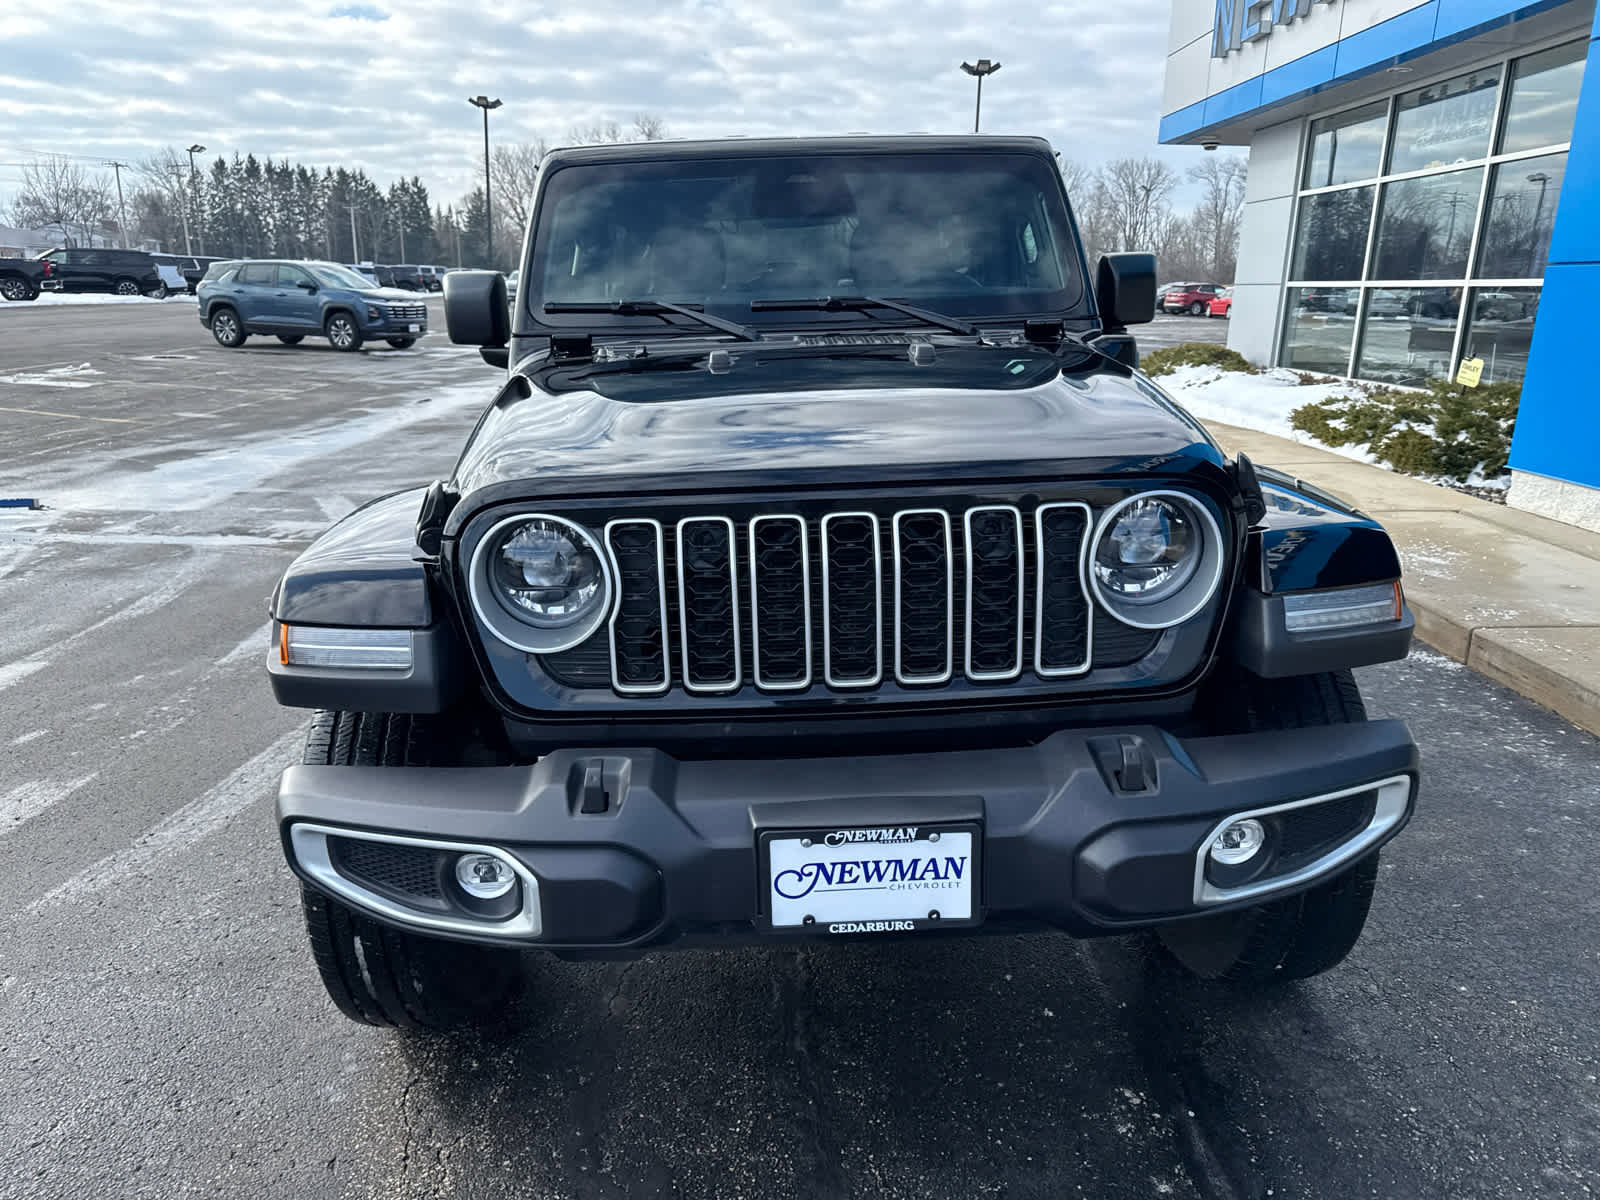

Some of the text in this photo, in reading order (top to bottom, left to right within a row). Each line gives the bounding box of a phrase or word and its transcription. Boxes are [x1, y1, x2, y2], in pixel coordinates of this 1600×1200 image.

[824, 827, 918, 848] NEWMAN
[774, 857, 967, 899] NEWMAN
[889, 881, 961, 892] CHEVROLET
[829, 921, 915, 934] CEDARBURG
